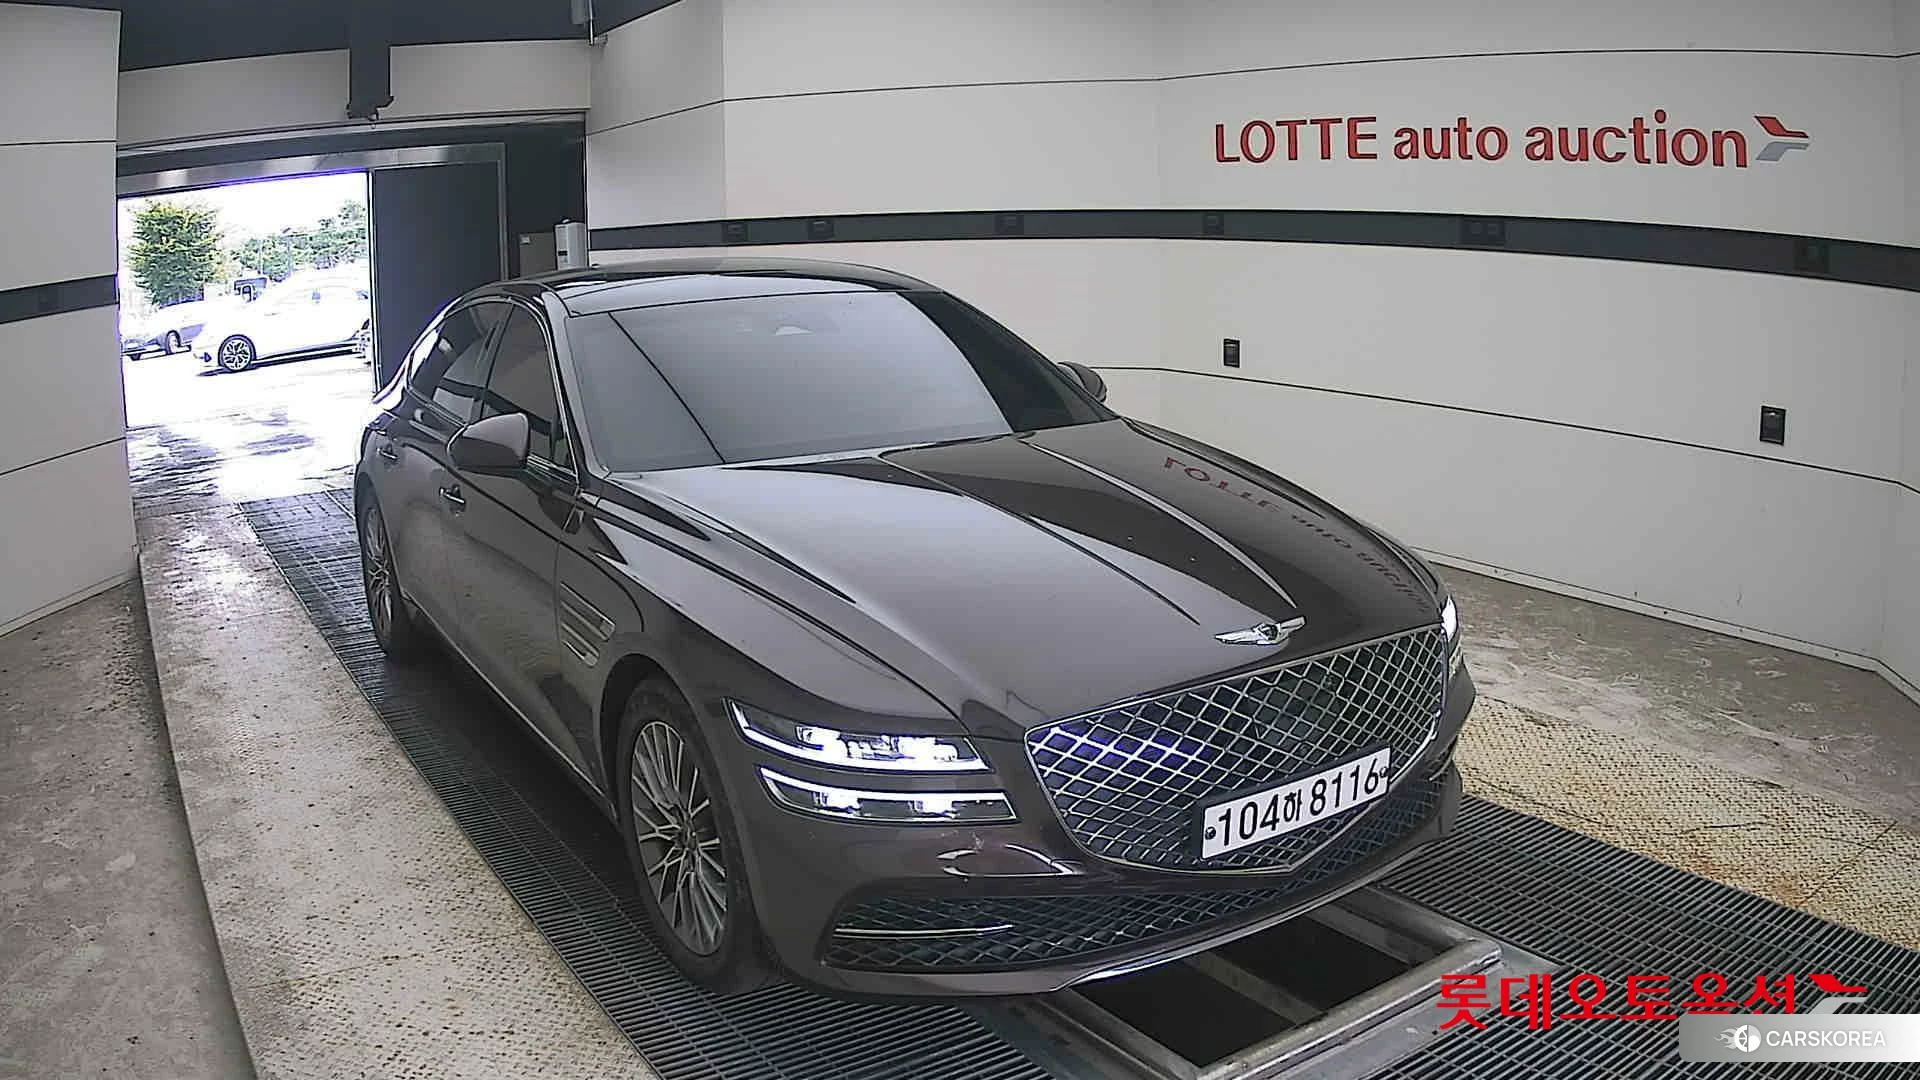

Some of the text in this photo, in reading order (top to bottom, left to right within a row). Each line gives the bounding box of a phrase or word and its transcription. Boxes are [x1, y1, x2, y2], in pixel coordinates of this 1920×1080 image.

[1214, 109, 1749, 168] LOTTE auto auction
[1218, 757, 1379, 848] 104하 8116
